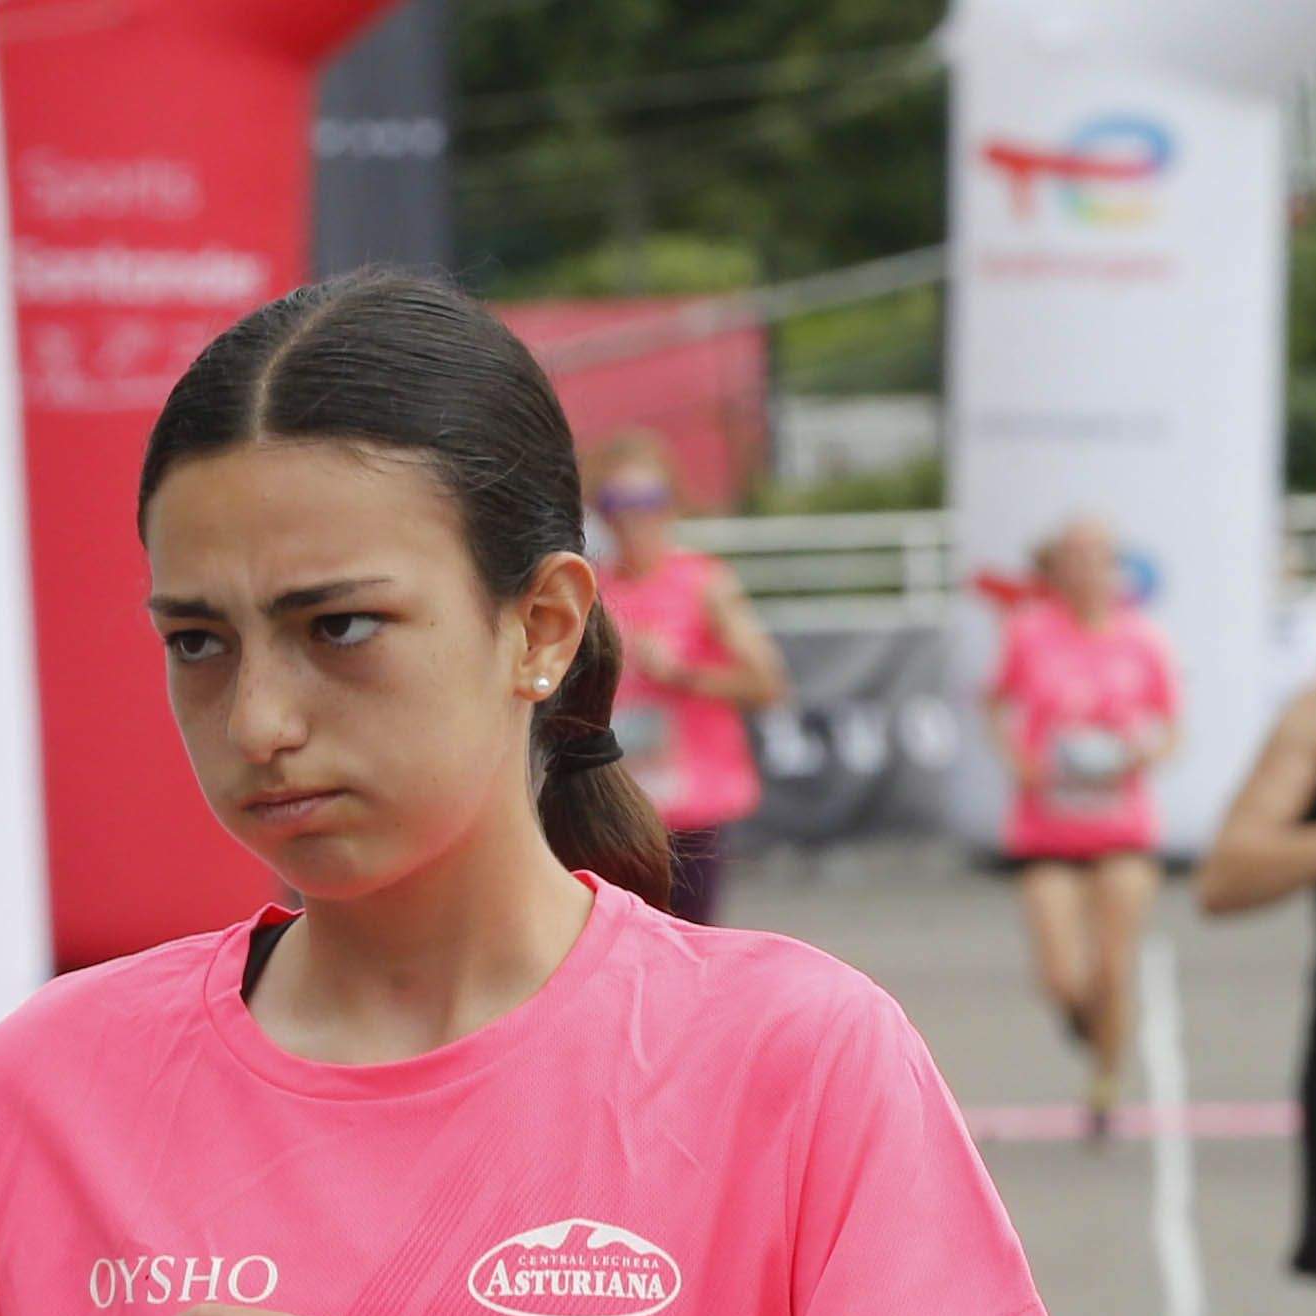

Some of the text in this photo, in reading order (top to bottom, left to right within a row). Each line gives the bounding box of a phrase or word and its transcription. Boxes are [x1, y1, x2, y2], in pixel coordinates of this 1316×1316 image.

[89, 1254, 279, 1308] OYSHO
[484, 1258, 666, 1300] ASTURIANA
[518, 1254, 660, 1269] CENTRAL LECHERA
